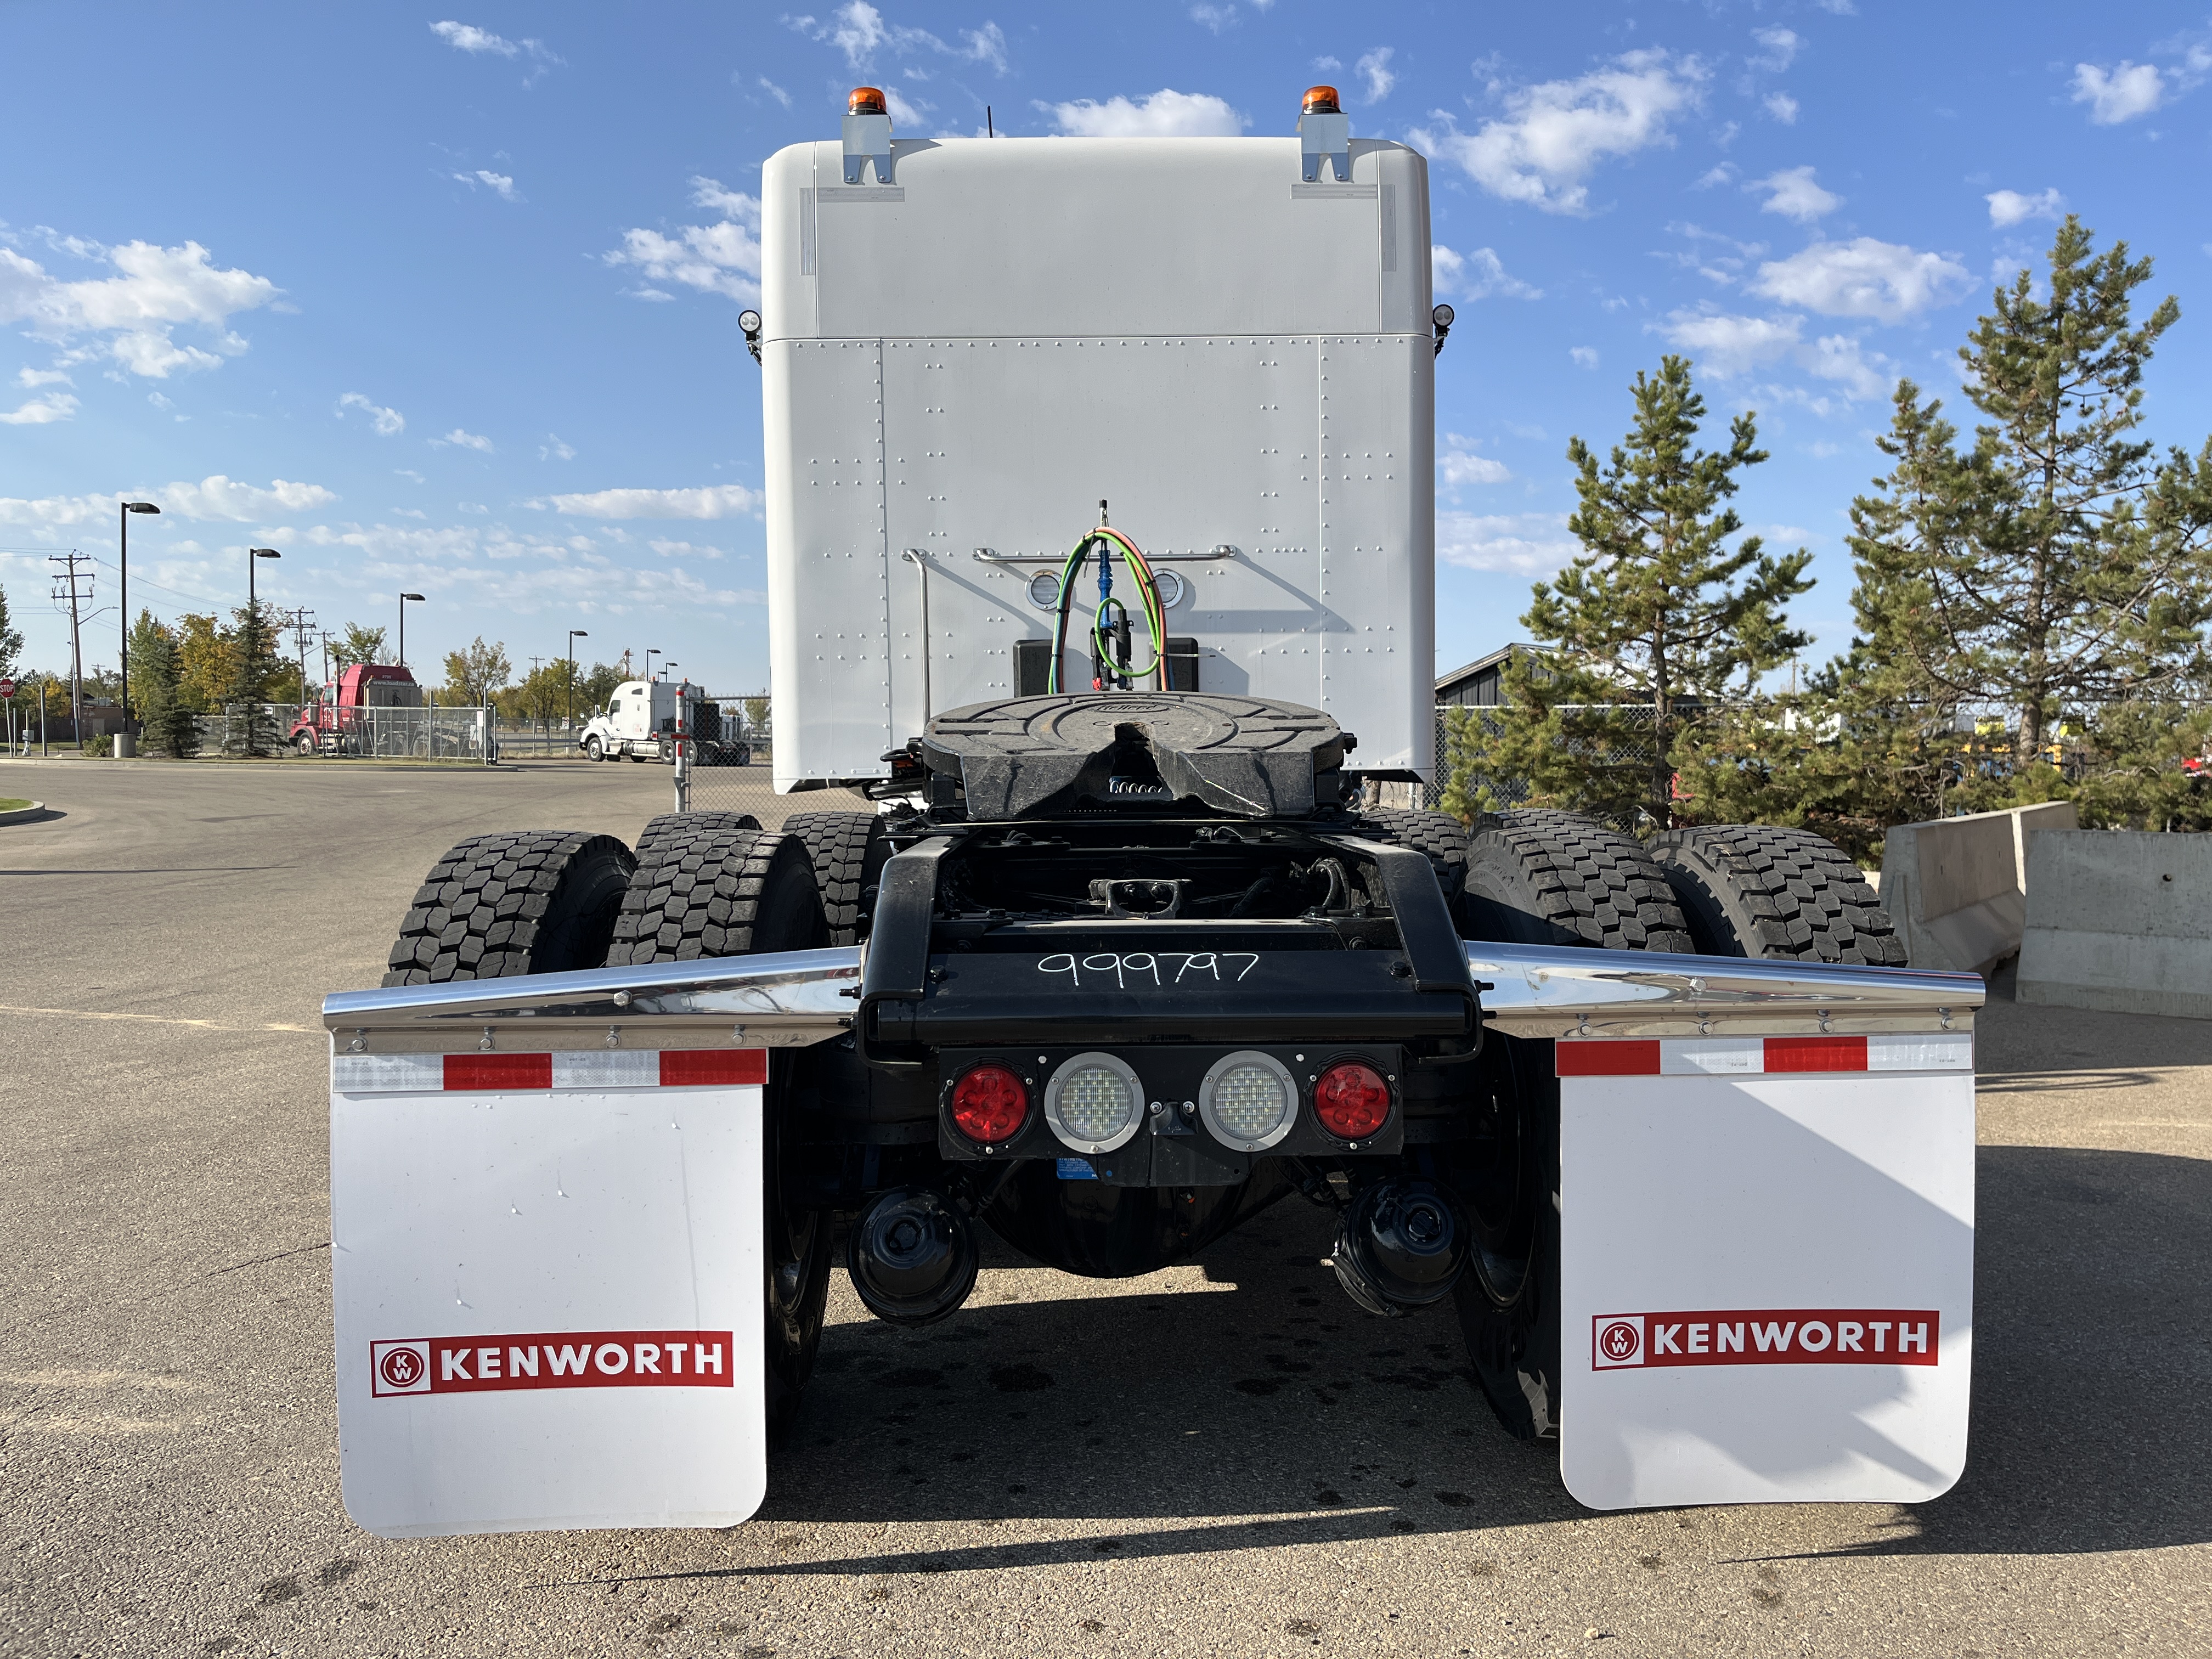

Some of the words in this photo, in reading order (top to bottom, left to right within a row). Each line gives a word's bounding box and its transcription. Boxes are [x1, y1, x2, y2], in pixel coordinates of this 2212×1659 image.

[0, 684, 14, 693] STOP
[1037, 952, 1259, 989] 999797
[1655, 1321, 1928, 1355] KENWORTH
[441, 1342, 722, 1380] KENWORTH
